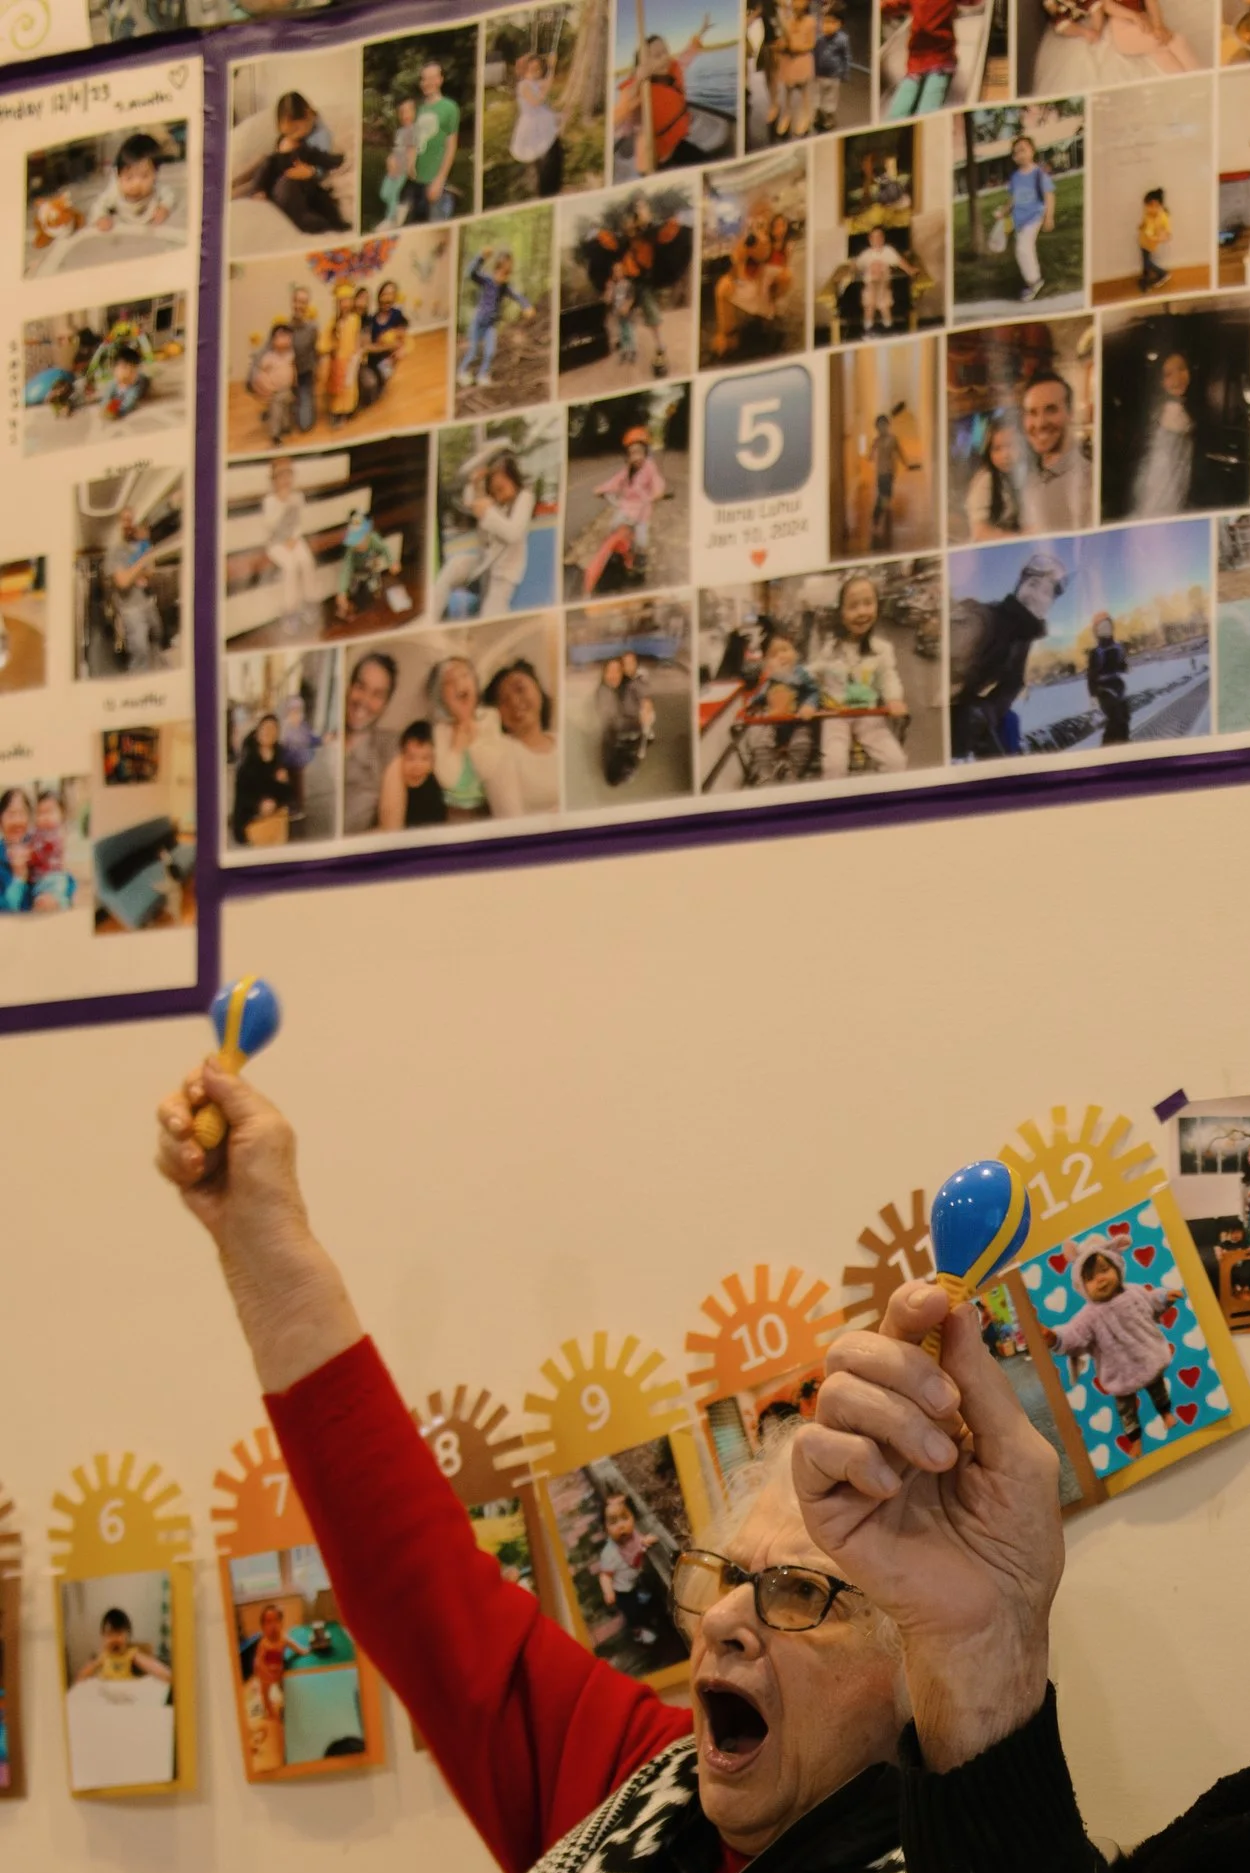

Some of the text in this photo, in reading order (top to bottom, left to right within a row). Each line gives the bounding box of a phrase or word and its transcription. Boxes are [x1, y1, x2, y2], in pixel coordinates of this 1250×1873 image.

[735, 398, 785, 471] 5
[705, 532, 738, 550] Jan
[1028, 1152, 1102, 1221] 12
[731, 1313, 789, 1372] 10
[579, 1383, 612, 1433] 9
[434, 1428, 462, 1477] 8
[262, 1472, 290, 1518] 7
[98, 1499, 126, 1544] 6
